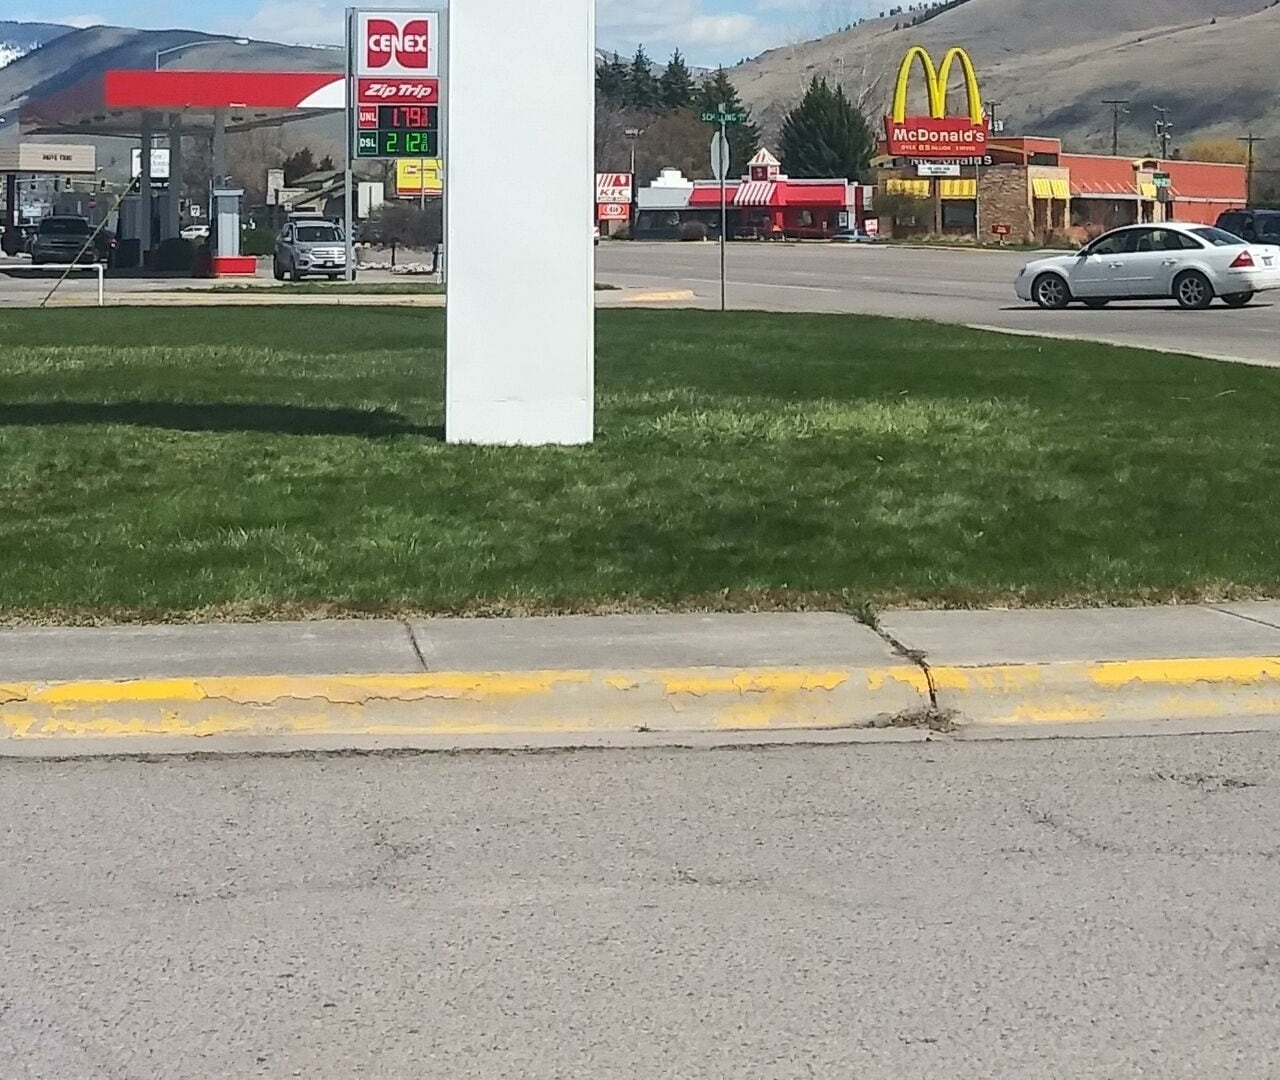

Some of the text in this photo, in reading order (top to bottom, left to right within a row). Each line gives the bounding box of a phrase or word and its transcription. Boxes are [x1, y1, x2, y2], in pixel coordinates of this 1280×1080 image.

[369, 34, 427, 53] CENEX
[364, 83, 432, 99] Zip Trip
[360, 111, 377, 122] UNL
[893, 128, 985, 142] McDonald's
[360, 138, 377, 148] DSL
[599, 188, 631, 196] KFC
